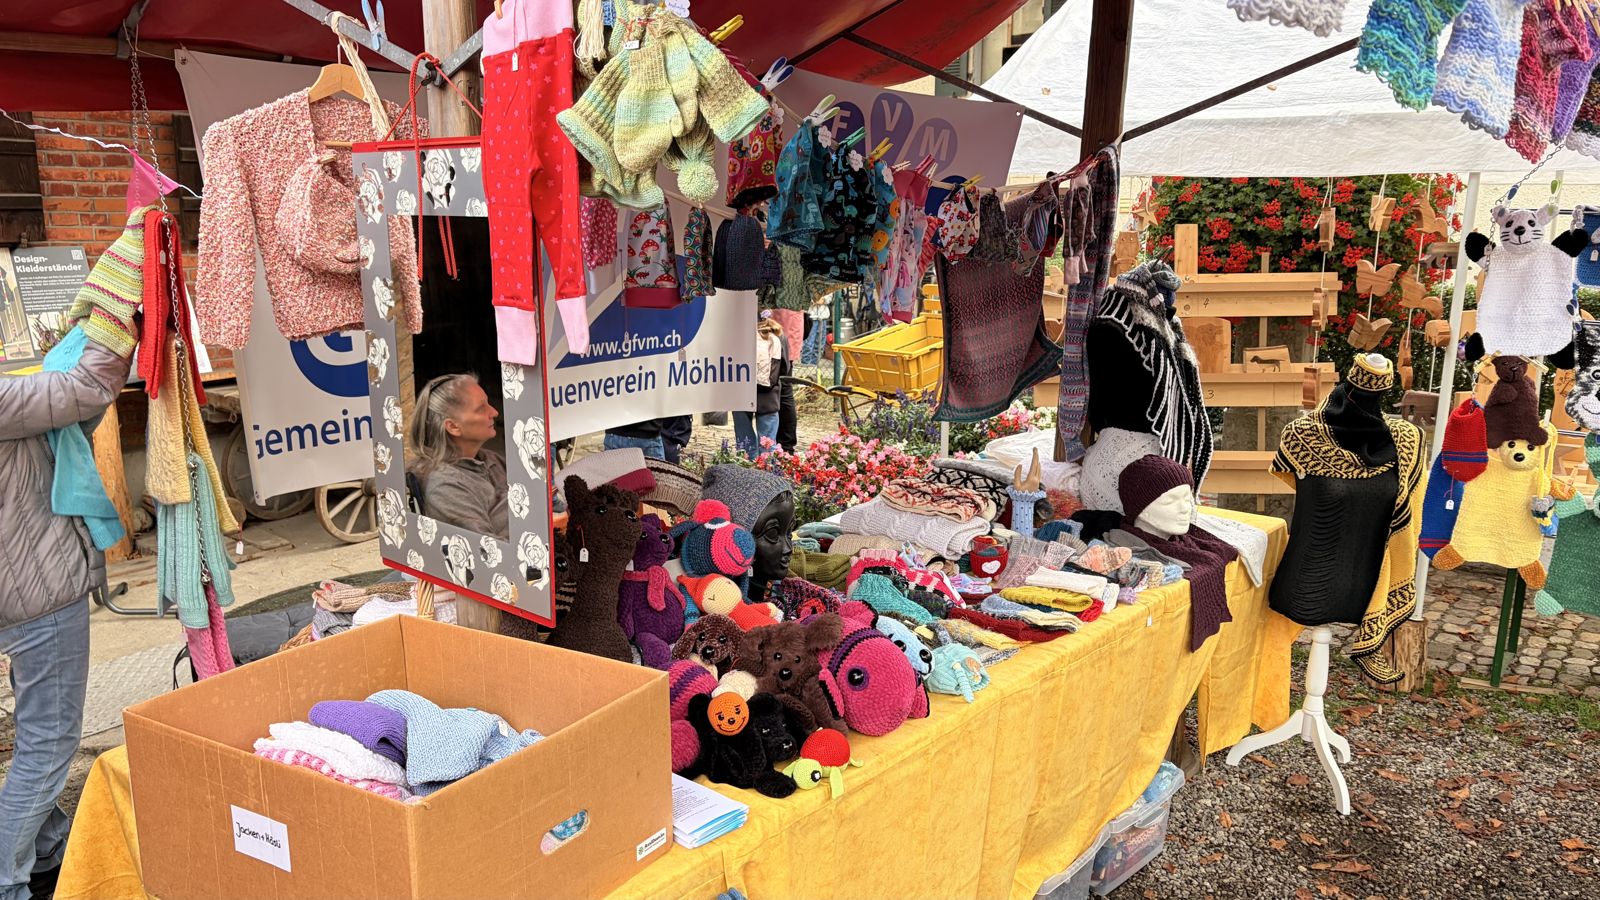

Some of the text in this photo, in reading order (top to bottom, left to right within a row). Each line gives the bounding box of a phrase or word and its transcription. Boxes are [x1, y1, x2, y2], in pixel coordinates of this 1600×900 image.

[832, 110, 851, 139] F
[882, 100, 903, 131] V
[919, 127, 949, 161] M
[14, 255, 48, 264] Design-
[16, 263, 82, 273] Kleiderständer
[551, 356, 750, 407] uenverein Möhlin
